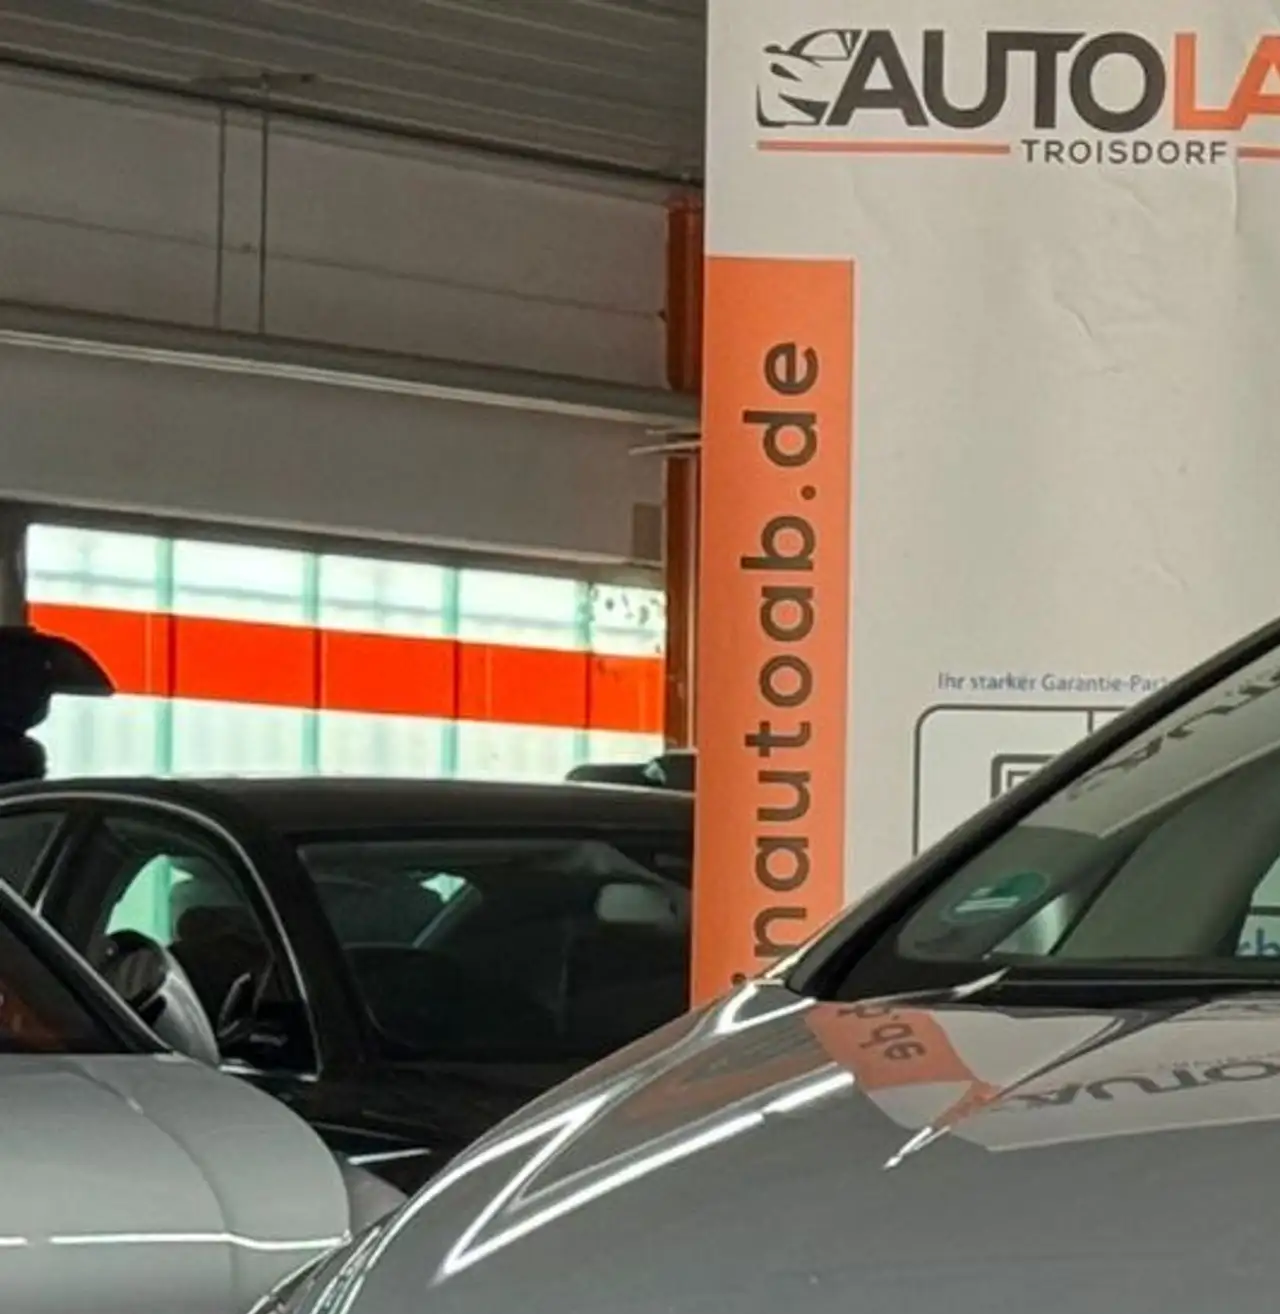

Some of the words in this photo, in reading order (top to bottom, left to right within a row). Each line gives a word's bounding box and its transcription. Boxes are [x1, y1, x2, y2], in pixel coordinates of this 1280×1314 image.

[1020, 138, 1230, 165] TROISDORF
[731, 340, 819, 988] nautoab.de
[937, 671, 965, 691] Ihr
[969, 671, 1036, 692] starker
